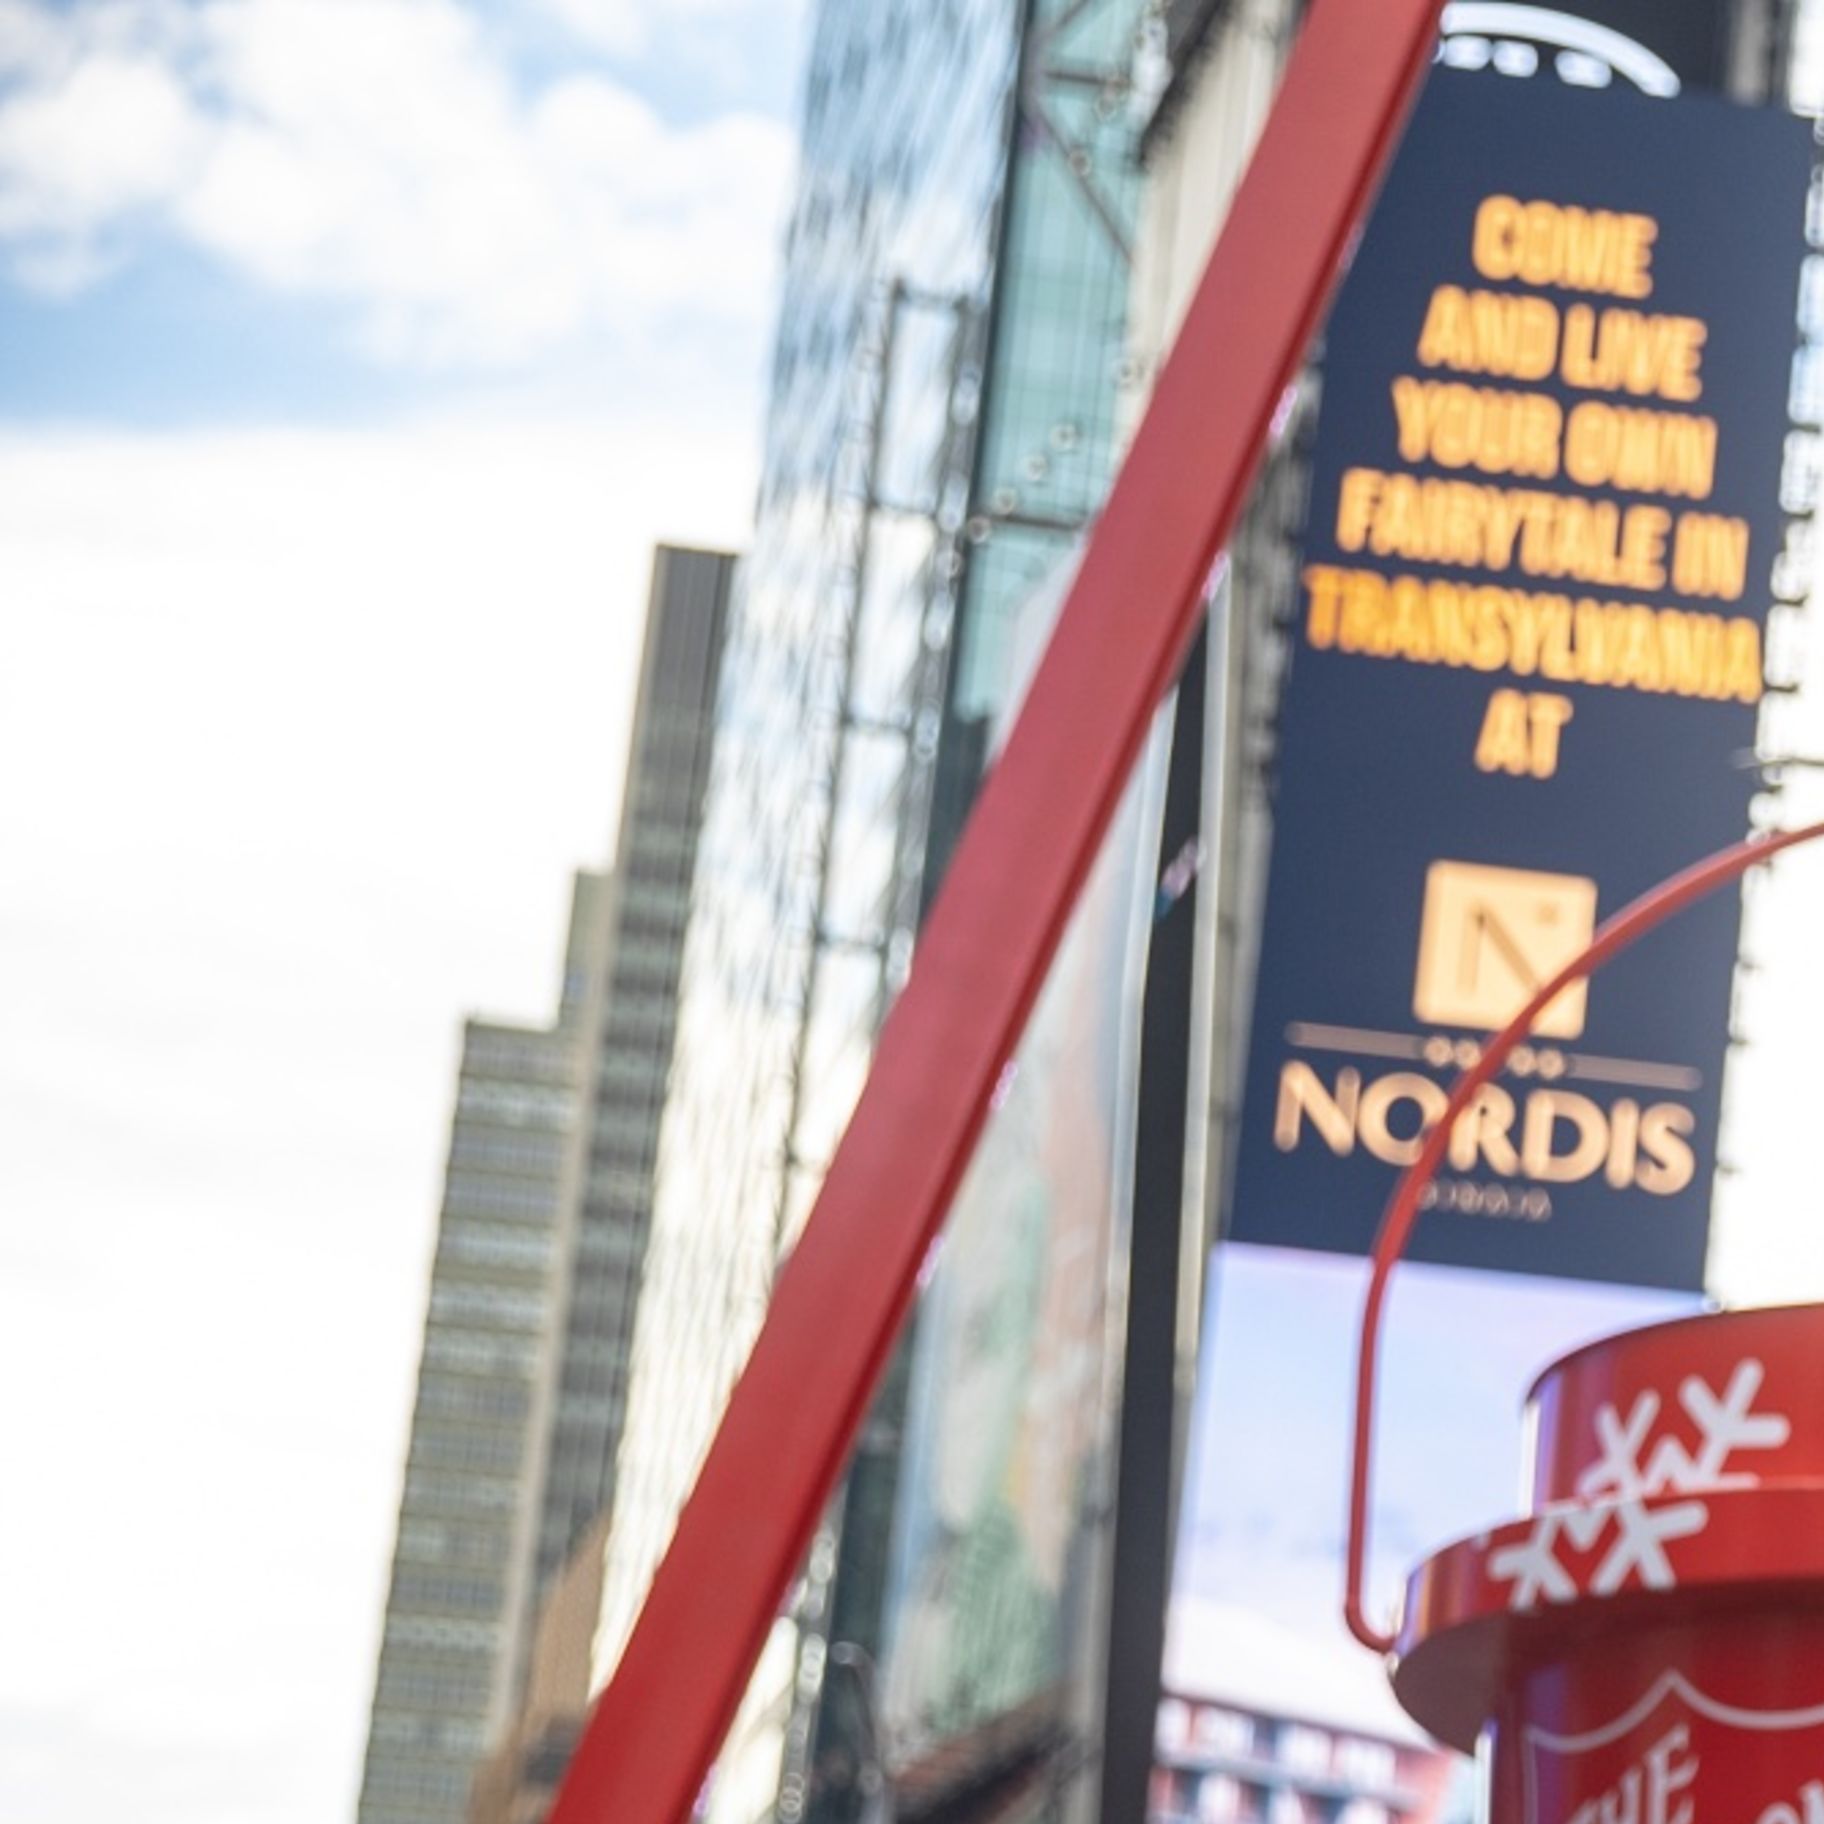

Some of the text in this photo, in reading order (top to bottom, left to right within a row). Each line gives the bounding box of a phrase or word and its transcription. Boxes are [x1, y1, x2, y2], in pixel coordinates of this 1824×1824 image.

[1472, 194, 1657, 298] COME
[1416, 284, 1707, 401] AND LIVE
[1391, 375, 1718, 499] YOUR OWN
[1336, 467, 1750, 600] FAIRYTALE IN
[1473, 687, 1573, 781] AT
[1273, 1060, 1696, 1196] NORDIS
